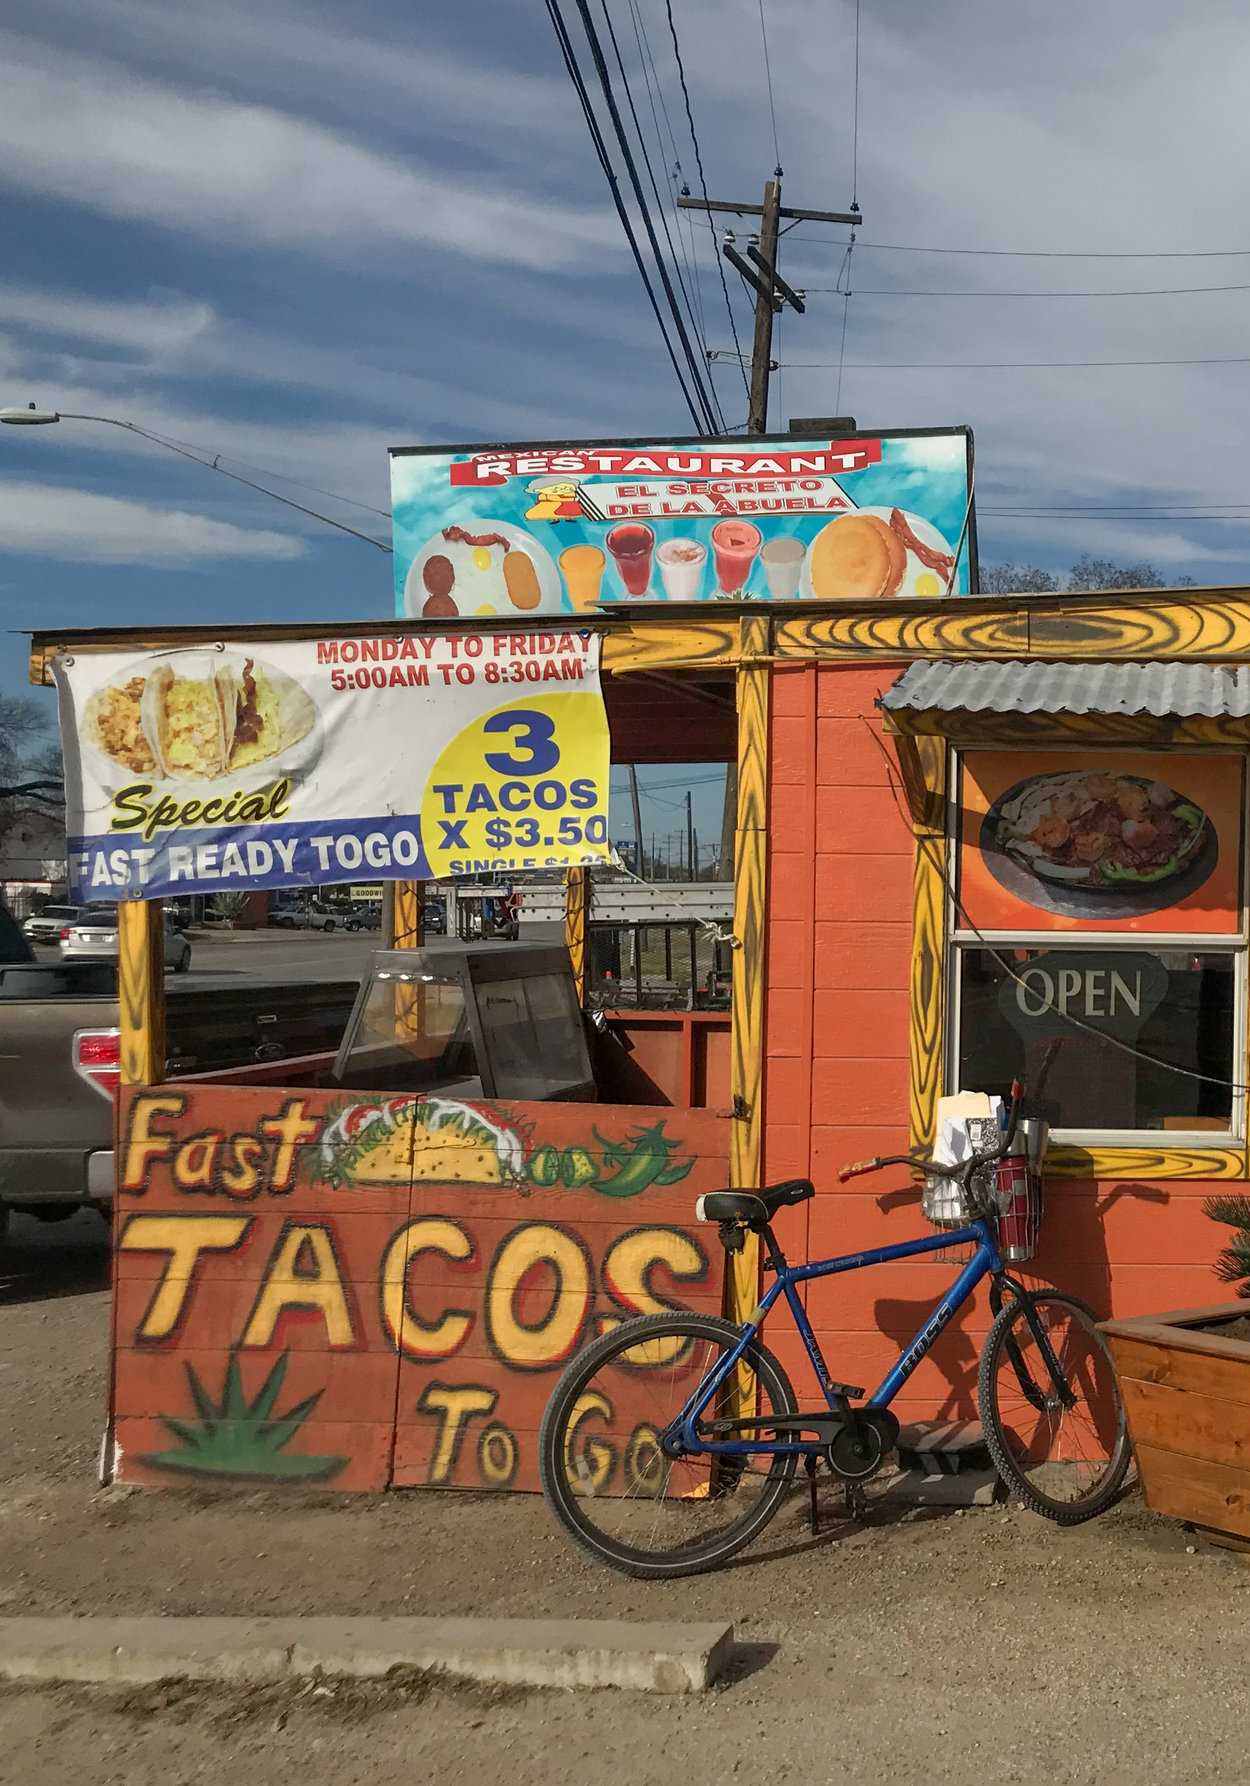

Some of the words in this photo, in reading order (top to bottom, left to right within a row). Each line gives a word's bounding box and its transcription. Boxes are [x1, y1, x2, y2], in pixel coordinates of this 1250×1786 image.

[476, 450, 596, 462] MEXICAN
[477, 452, 866, 479] RESTAURANT
[607, 503, 651, 516] DE
[661, 500, 705, 514] LA
[713, 496, 850, 514] ABUELA
[617, 485, 657, 498] EL
[668, 479, 824, 496] SECRETO
[317, 635, 434, 665] MONDAY
[446, 635, 484, 658] TO
[493, 630, 592, 657] FRIDAY
[331, 664, 430, 691] 5:00AM
[437, 662, 475, 686] TO
[485, 658, 585, 683] 8:30AM
[484, 709, 561, 777] 3
[111, 778, 290, 841] Special
[432, 778, 599, 814] TACOS
[437, 819, 471, 850] X
[485, 815, 608, 850] $3.50
[70, 848, 155, 888] FAST
[168, 837, 299, 882] READY
[310, 830, 419, 871] TOGO
[1016, 968, 1141, 1016] OPEN
[119, 1093, 322, 1199] Fast
[119, 1211, 710, 1371] TACOS
[416, 1381, 520, 1486] To
[562, 1386, 668, 1496] Go
